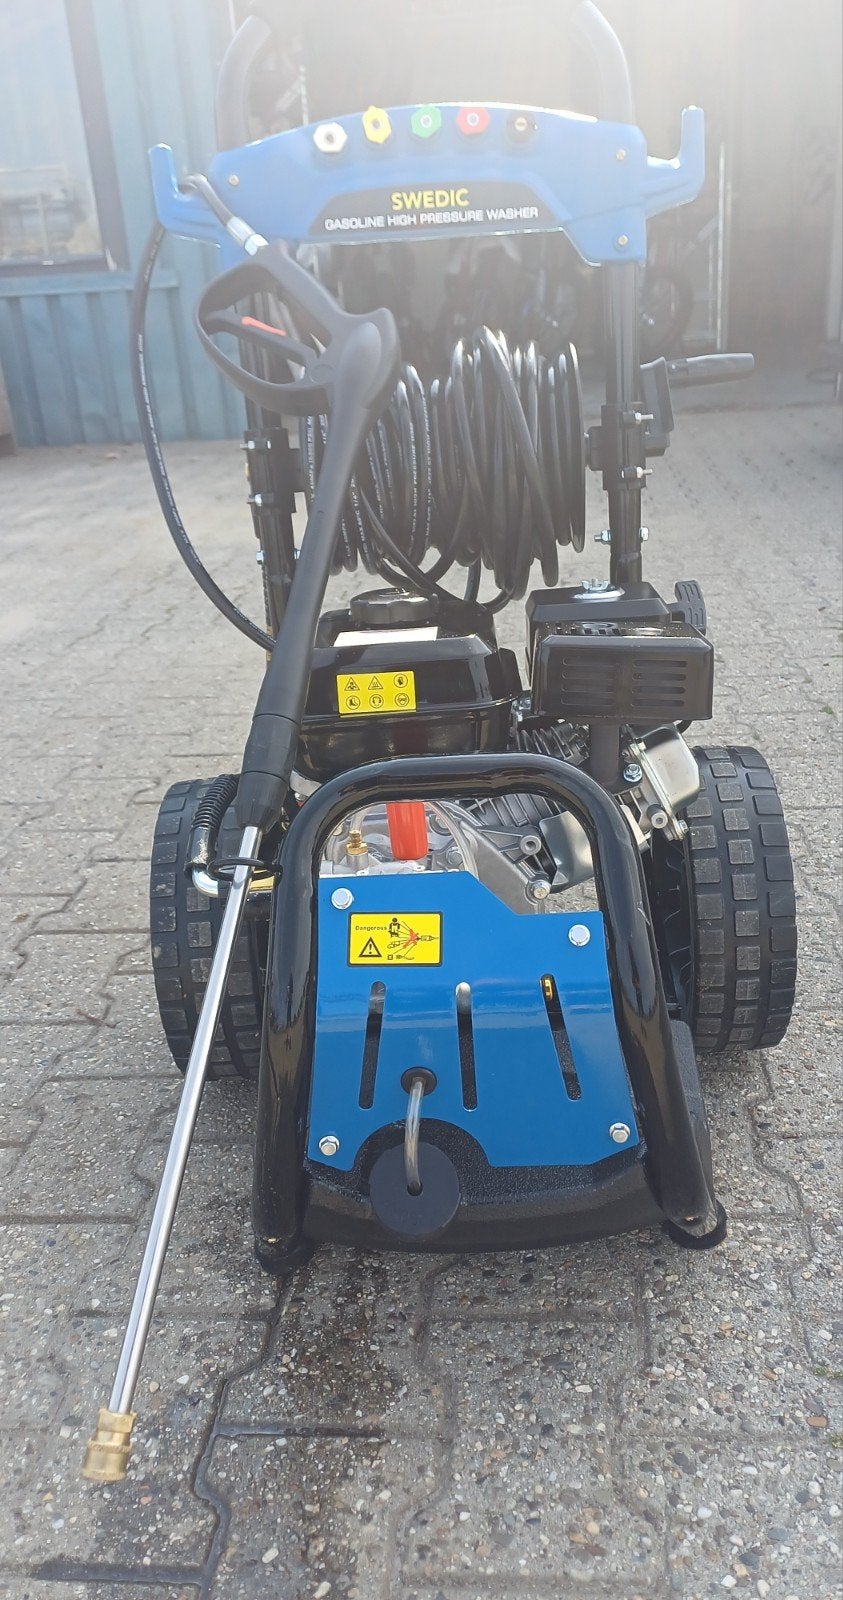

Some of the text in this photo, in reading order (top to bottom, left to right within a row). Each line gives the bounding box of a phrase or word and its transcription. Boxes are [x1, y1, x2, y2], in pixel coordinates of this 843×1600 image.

[391, 188, 470, 211] SWEDIC
[324, 206, 539, 231] GASOLINE HIGH PRESSURE WASHER
